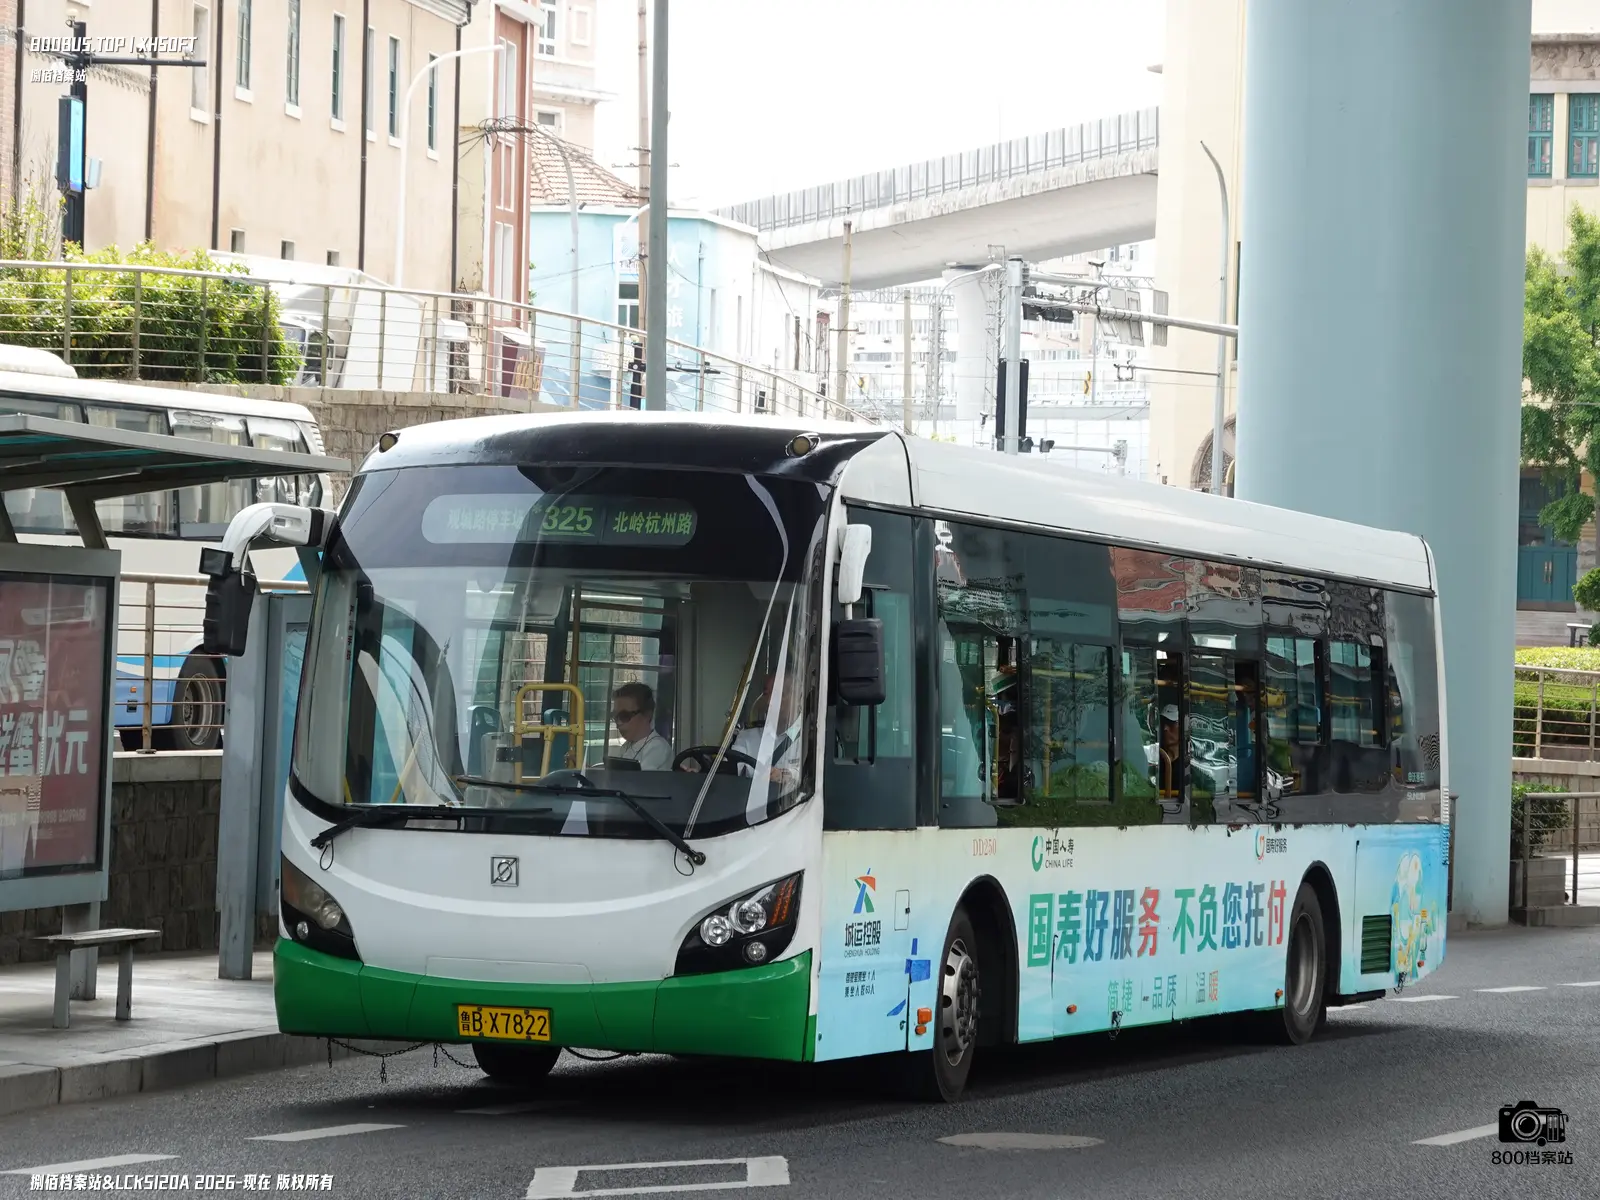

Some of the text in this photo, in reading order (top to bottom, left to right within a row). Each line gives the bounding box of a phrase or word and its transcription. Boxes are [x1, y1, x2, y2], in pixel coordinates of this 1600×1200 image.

[542, 505, 593, 532] 325
[612, 511, 693, 535] 北岭杭州路
[973, 838, 997, 857] DD250
[1045, 838, 1074, 856] 中国人寿
[1045, 859, 1074, 869] CHINA LIFE
[844, 920, 881, 948] 城运控股
[1027, 879, 1287, 968] 国寿好服务 不负您托付
[1107, 970, 1219, 1015] 简捷 品质 温暖
